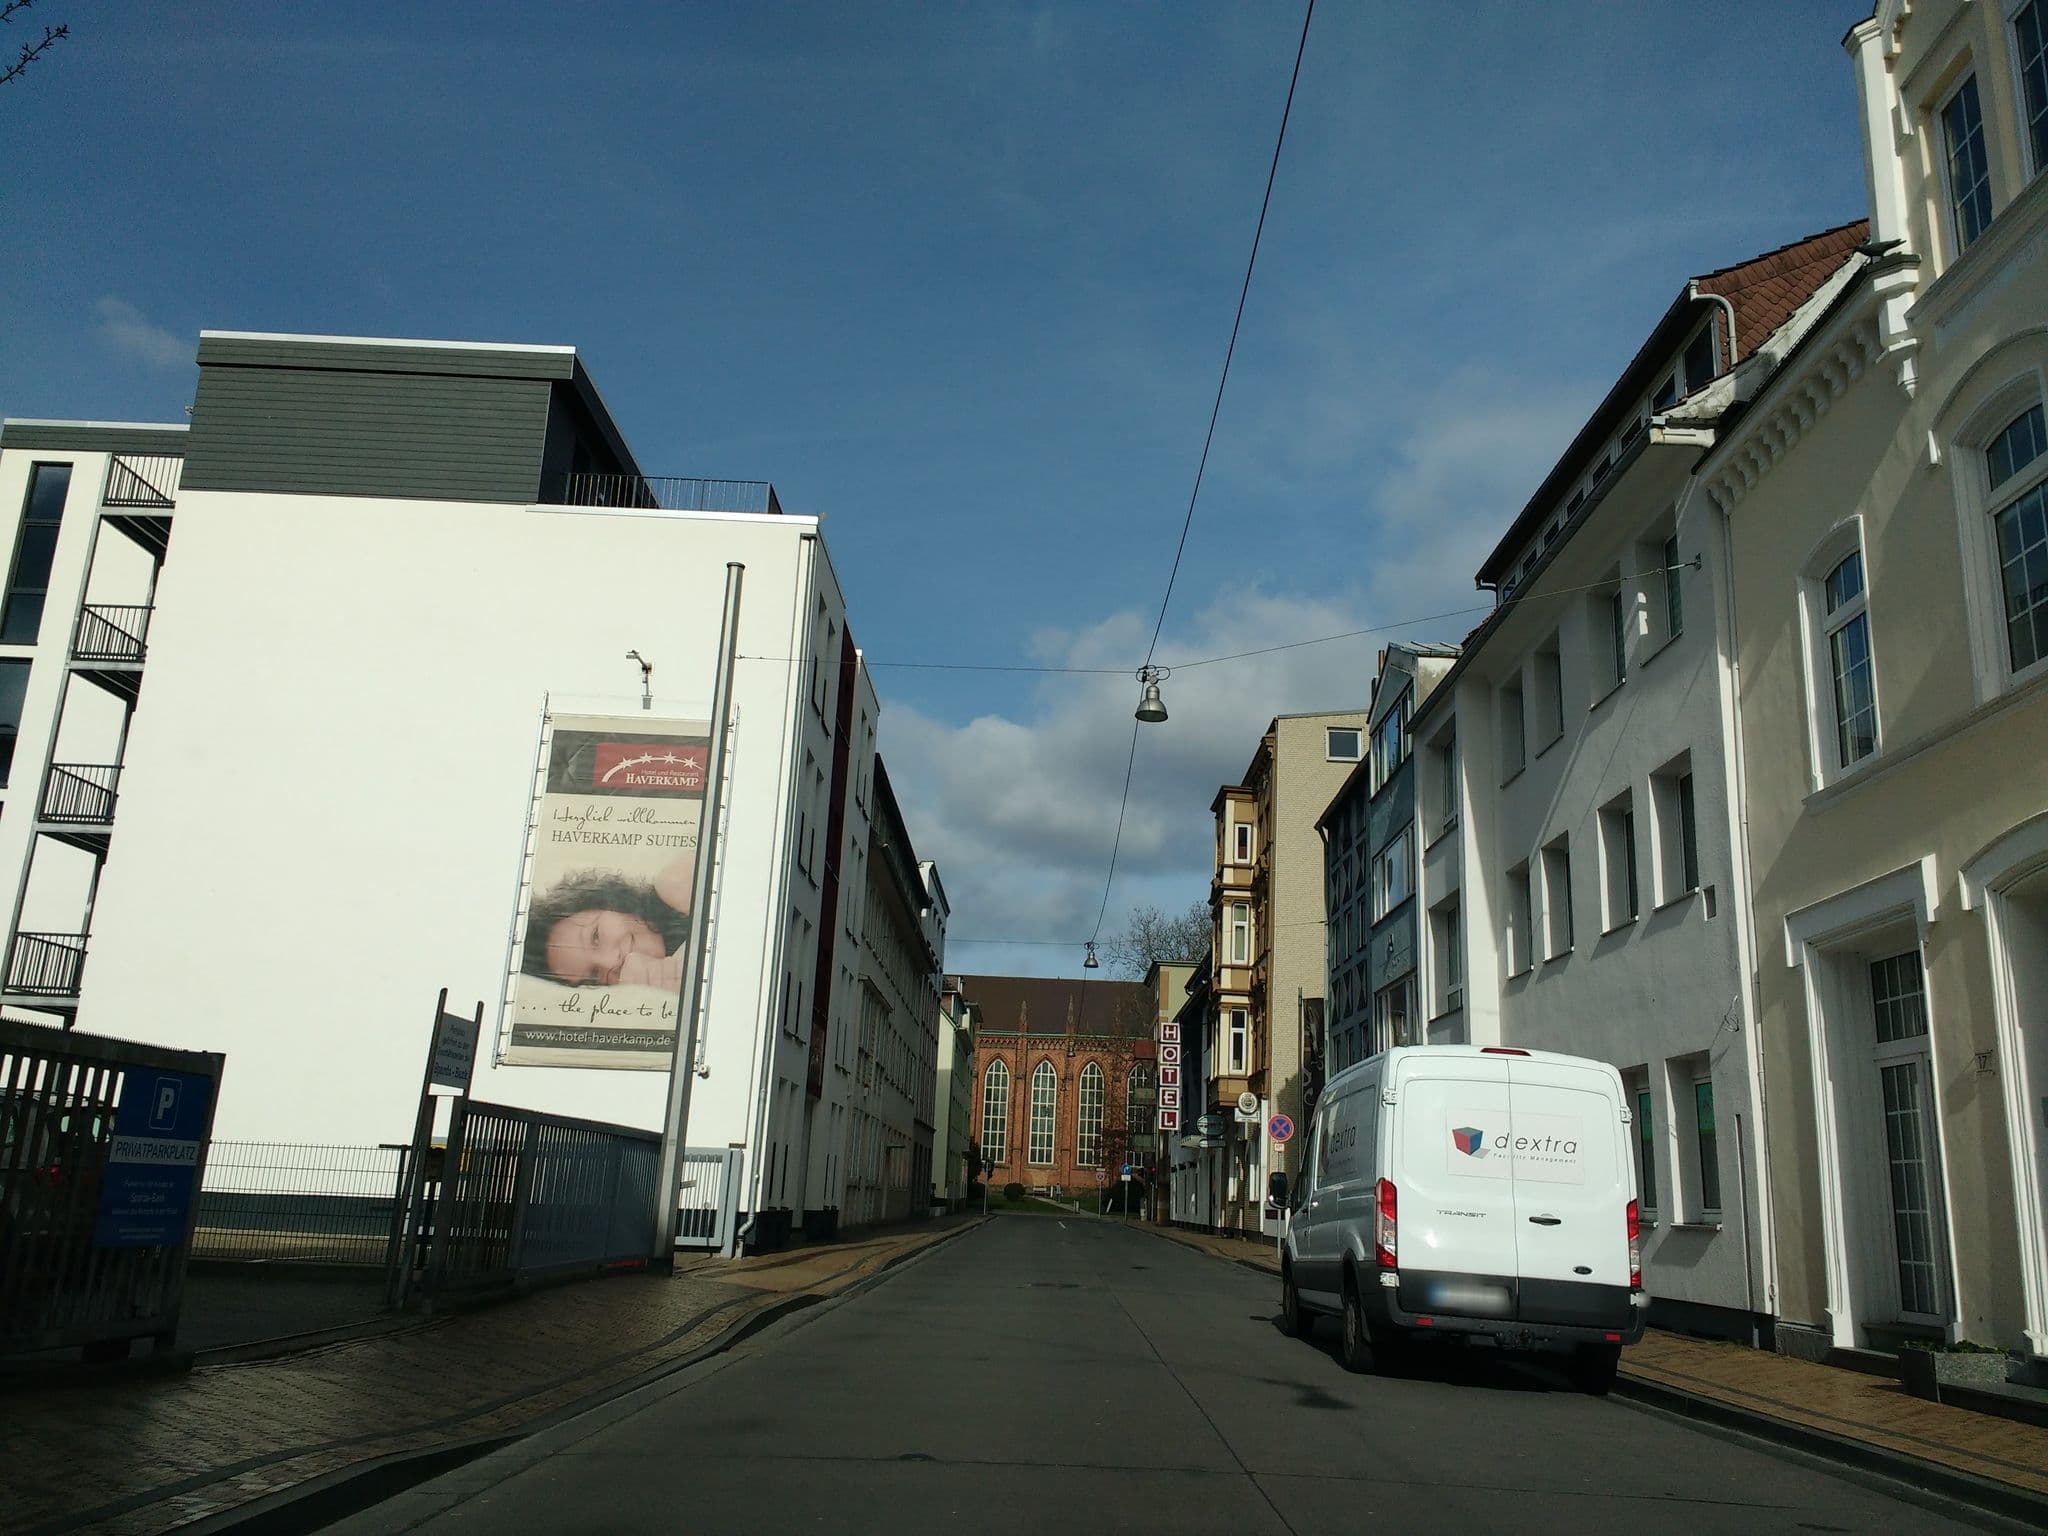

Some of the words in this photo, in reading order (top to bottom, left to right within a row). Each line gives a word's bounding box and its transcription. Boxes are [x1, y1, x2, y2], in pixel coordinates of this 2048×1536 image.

[626, 772, 699, 786] HAVERKAMP
[553, 804, 614, 830] Herzlich
[617, 806, 696, 825] willkommen
[551, 829, 643, 846] HAVERKAMP
[646, 834, 697, 848] SUITES
[557, 993, 585, 1013] the
[591, 994, 632, 1023] place
[636, 1003, 654, 1017] to
[661, 1000, 677, 1019] be
[525, 1030, 671, 1047] www.hotel-haverkamp.de
[1162, 1025, 1177, 1127] HOTEL
[156, 1087, 175, 1120] P
[116, 1141, 197, 1161] PRIVATPARKPLATZ
[1494, 1132, 1577, 1154] dextra
[1436, 1209, 1487, 1218] TRANSIT
